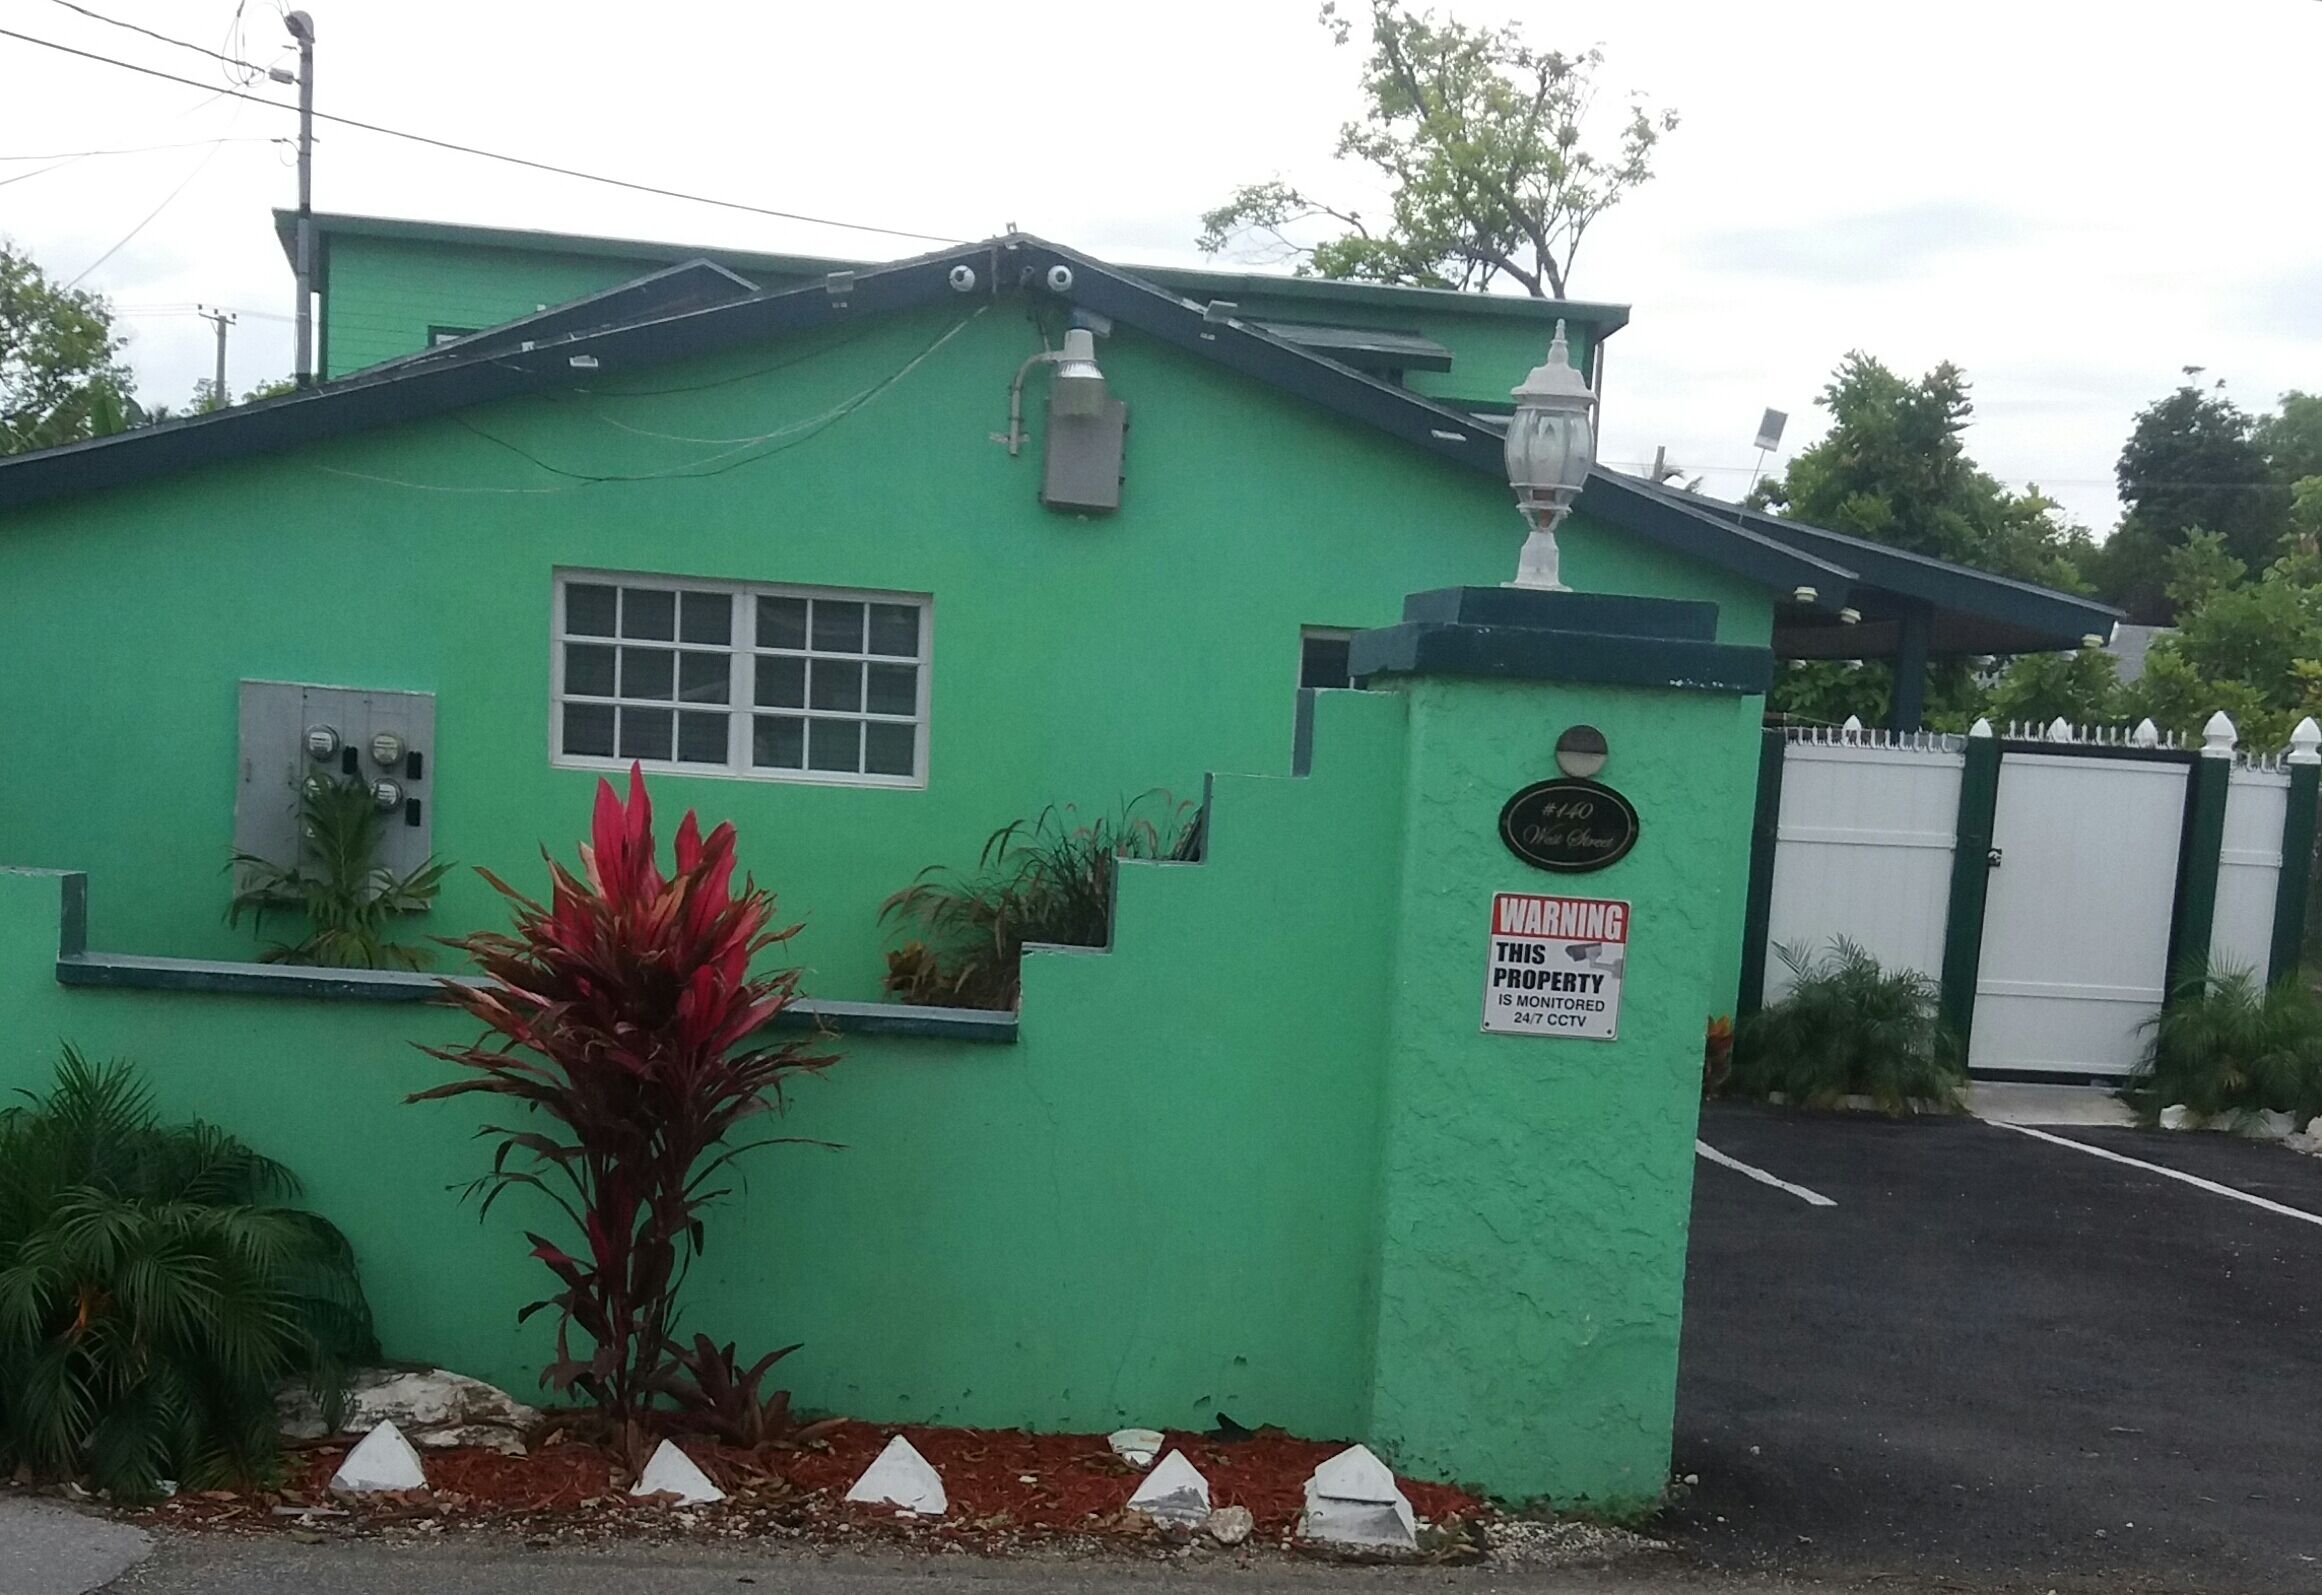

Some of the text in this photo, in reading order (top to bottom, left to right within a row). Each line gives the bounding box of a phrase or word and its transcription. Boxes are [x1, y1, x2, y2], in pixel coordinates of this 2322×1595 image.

[1500, 898, 1623, 940] WARNING
[1496, 942, 1546, 965] THIS
[1493, 967, 1605, 994] PROPERTY
[1498, 994, 1605, 1012] IS MONITORED
[1514, 1012, 1587, 1028] 24/7 CCTV
